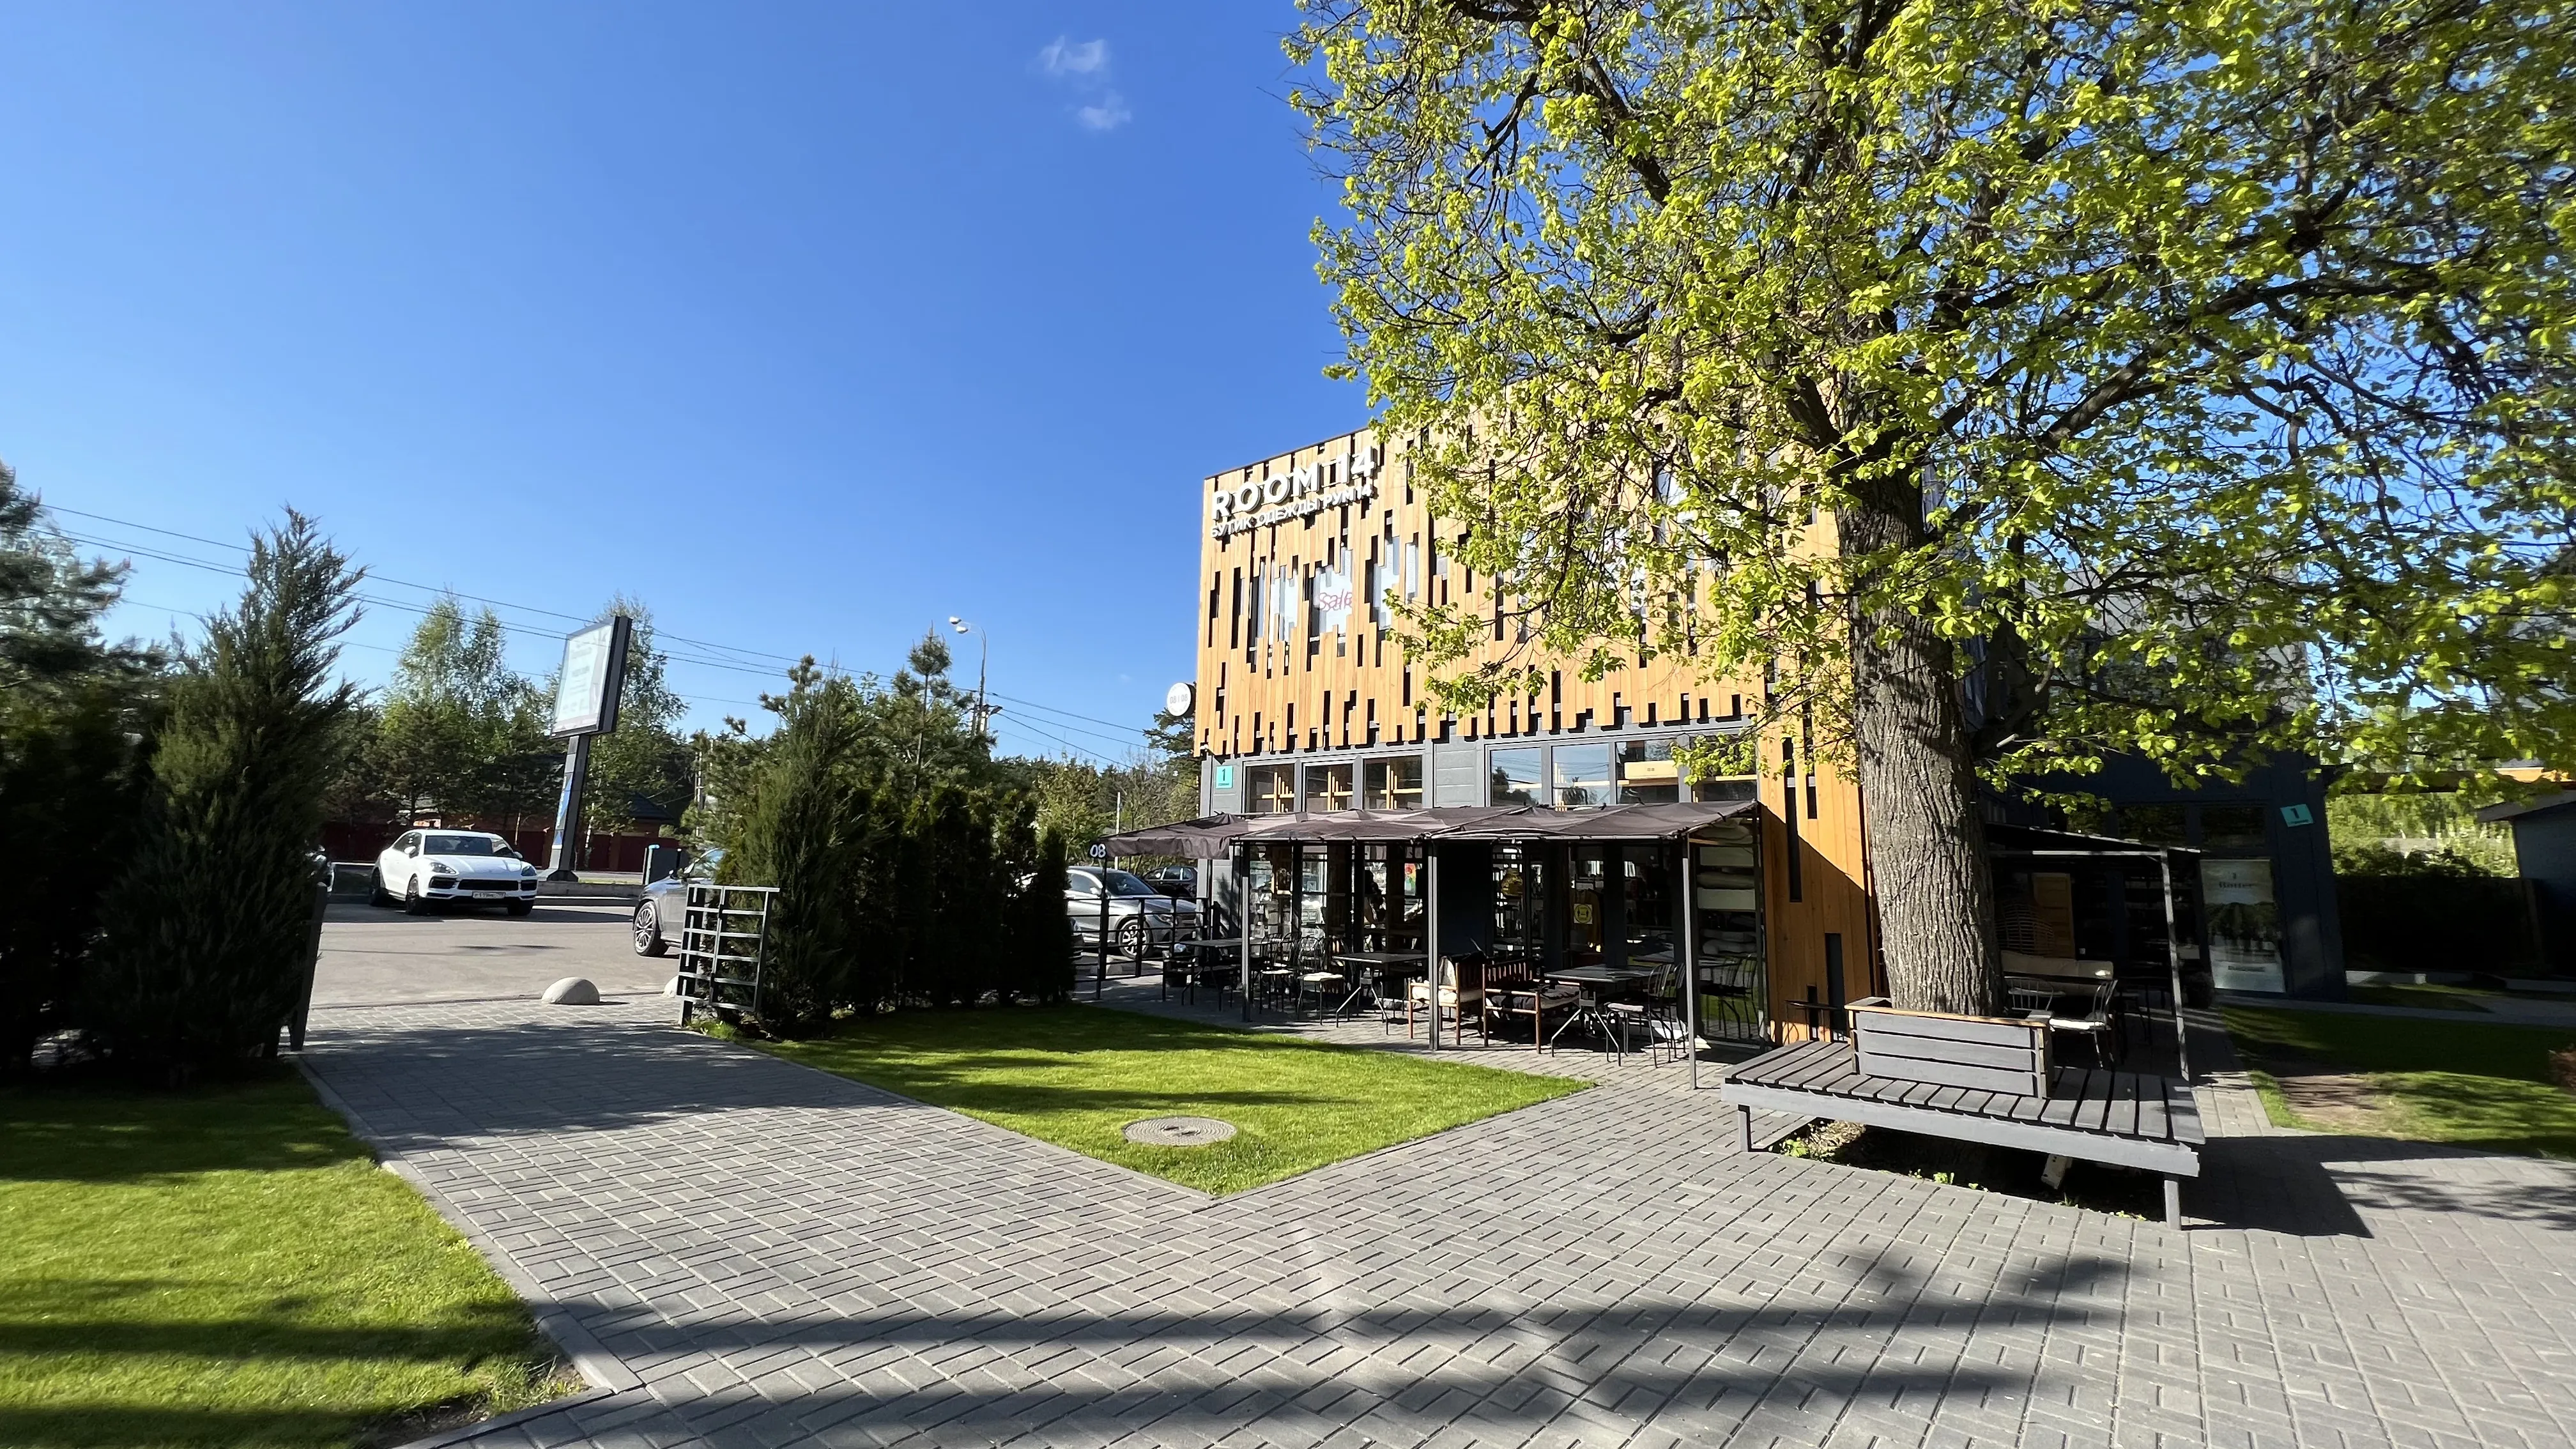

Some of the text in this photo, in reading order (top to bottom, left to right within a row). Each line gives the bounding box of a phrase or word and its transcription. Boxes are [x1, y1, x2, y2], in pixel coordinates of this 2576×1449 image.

[1212, 445, 1376, 519] ROOM 14
[1211, 516, 1252, 538] БУТИК
[1256, 498, 1319, 525] ОДЕЖДЫ
[1222, 768, 1226, 781] 1
[2290, 808, 2300, 818] 1
[1089, 843, 1106, 858] 08
